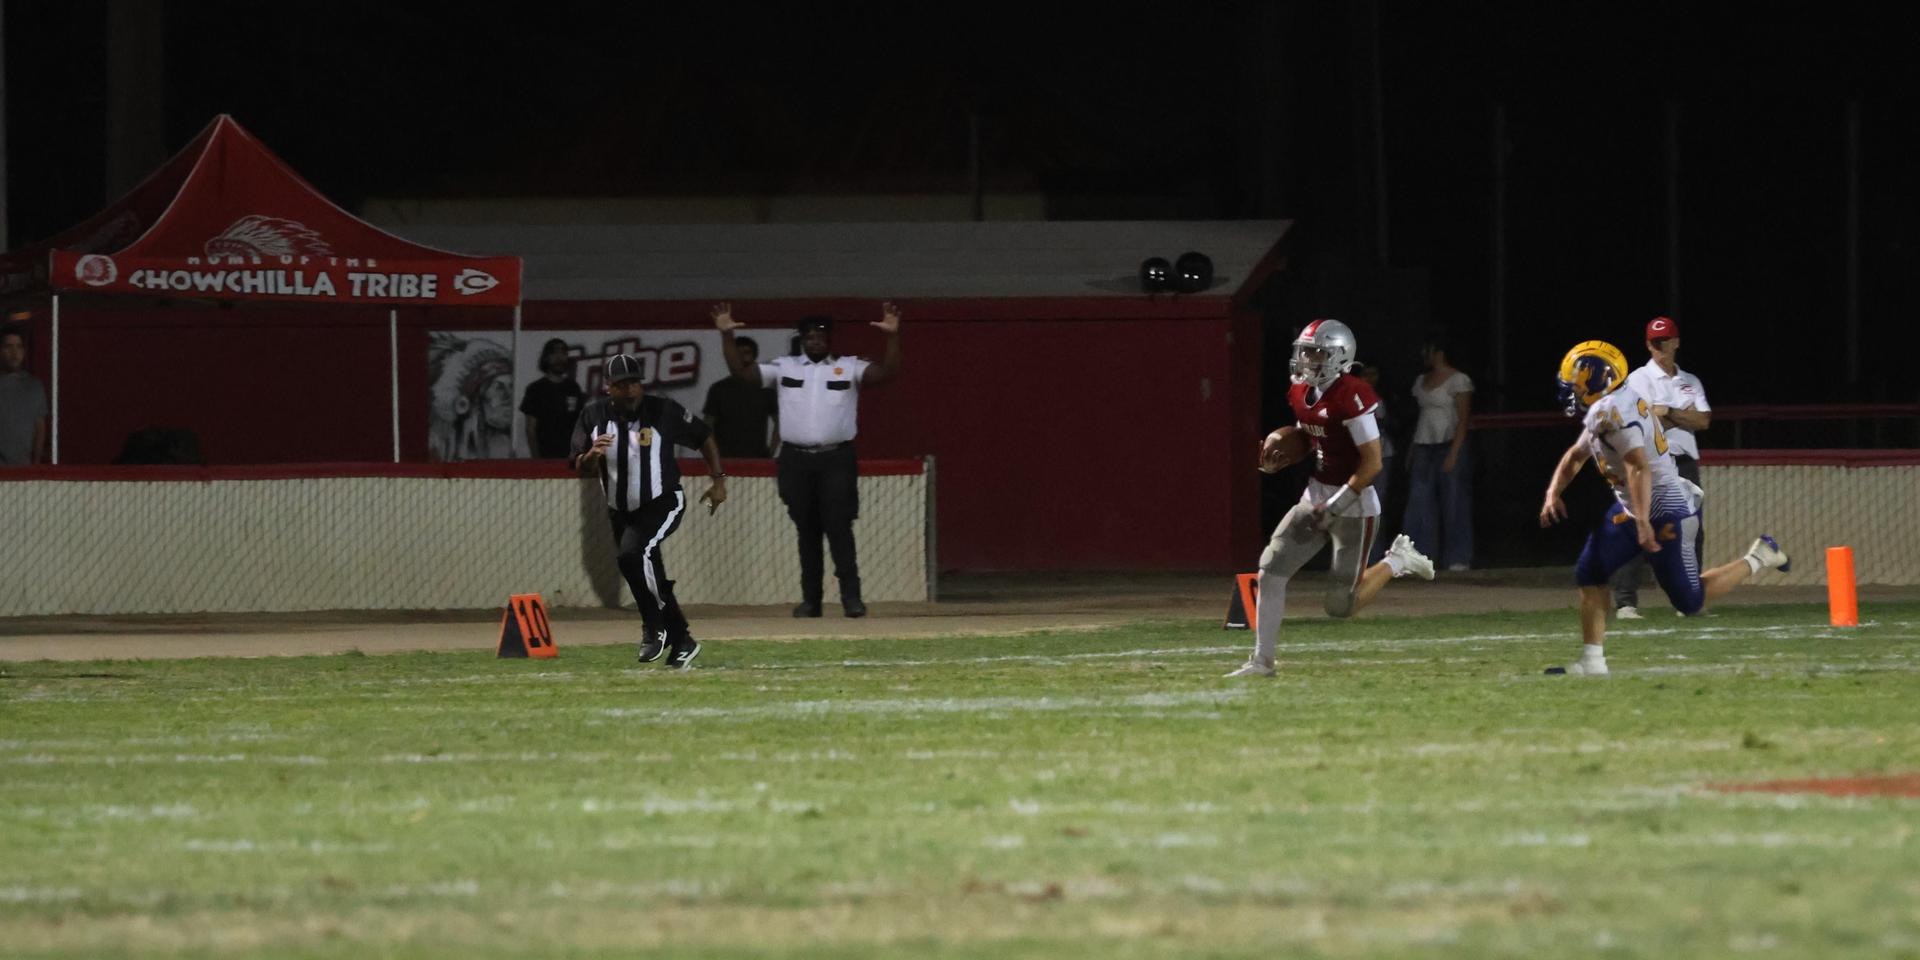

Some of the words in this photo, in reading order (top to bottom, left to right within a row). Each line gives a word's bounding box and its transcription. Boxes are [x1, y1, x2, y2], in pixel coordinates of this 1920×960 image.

[128, 268, 337, 297] CHOWCHILLA
[347, 271, 439, 299] TRIBE
[1651, 320, 1667, 331] C
[518, 599, 553, 649] 10
